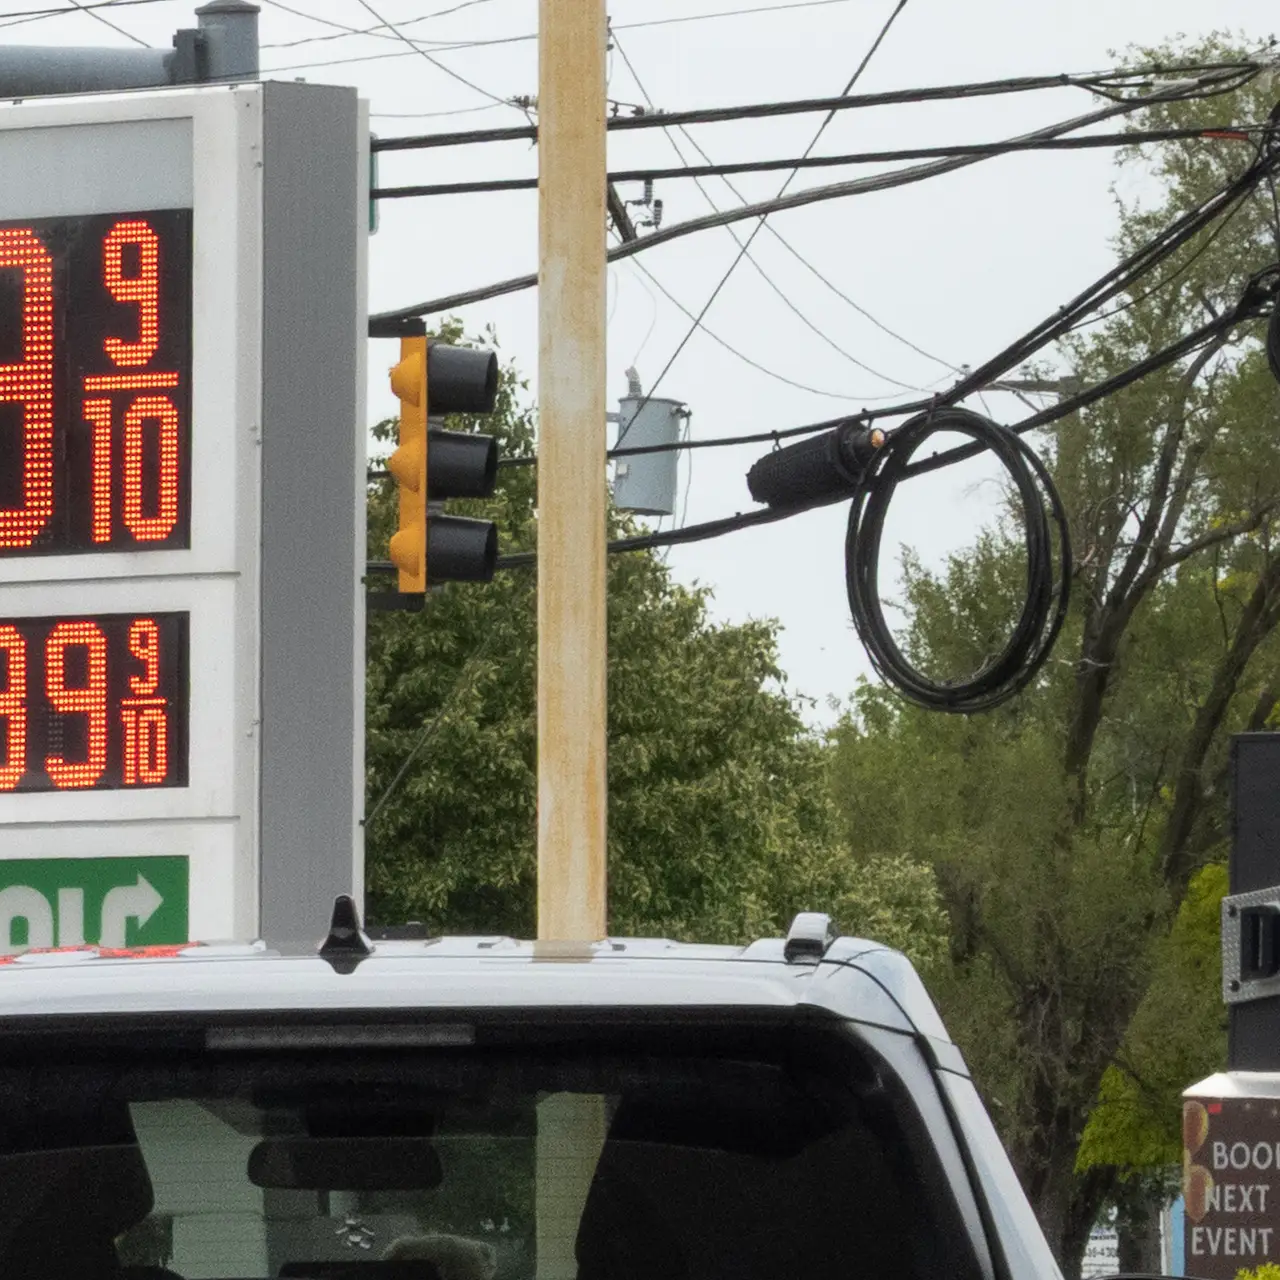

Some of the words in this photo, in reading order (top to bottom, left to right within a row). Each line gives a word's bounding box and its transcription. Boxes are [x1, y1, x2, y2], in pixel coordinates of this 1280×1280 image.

[103, 220, 159, 367] 9
[83, 396, 178, 543] 10
[129, 618, 161, 697] 9
[121, 708, 168, 785] 10
[1204, 1184, 1270, 1212] NEXT
[1193, 1228, 1273, 1256] EVENT
